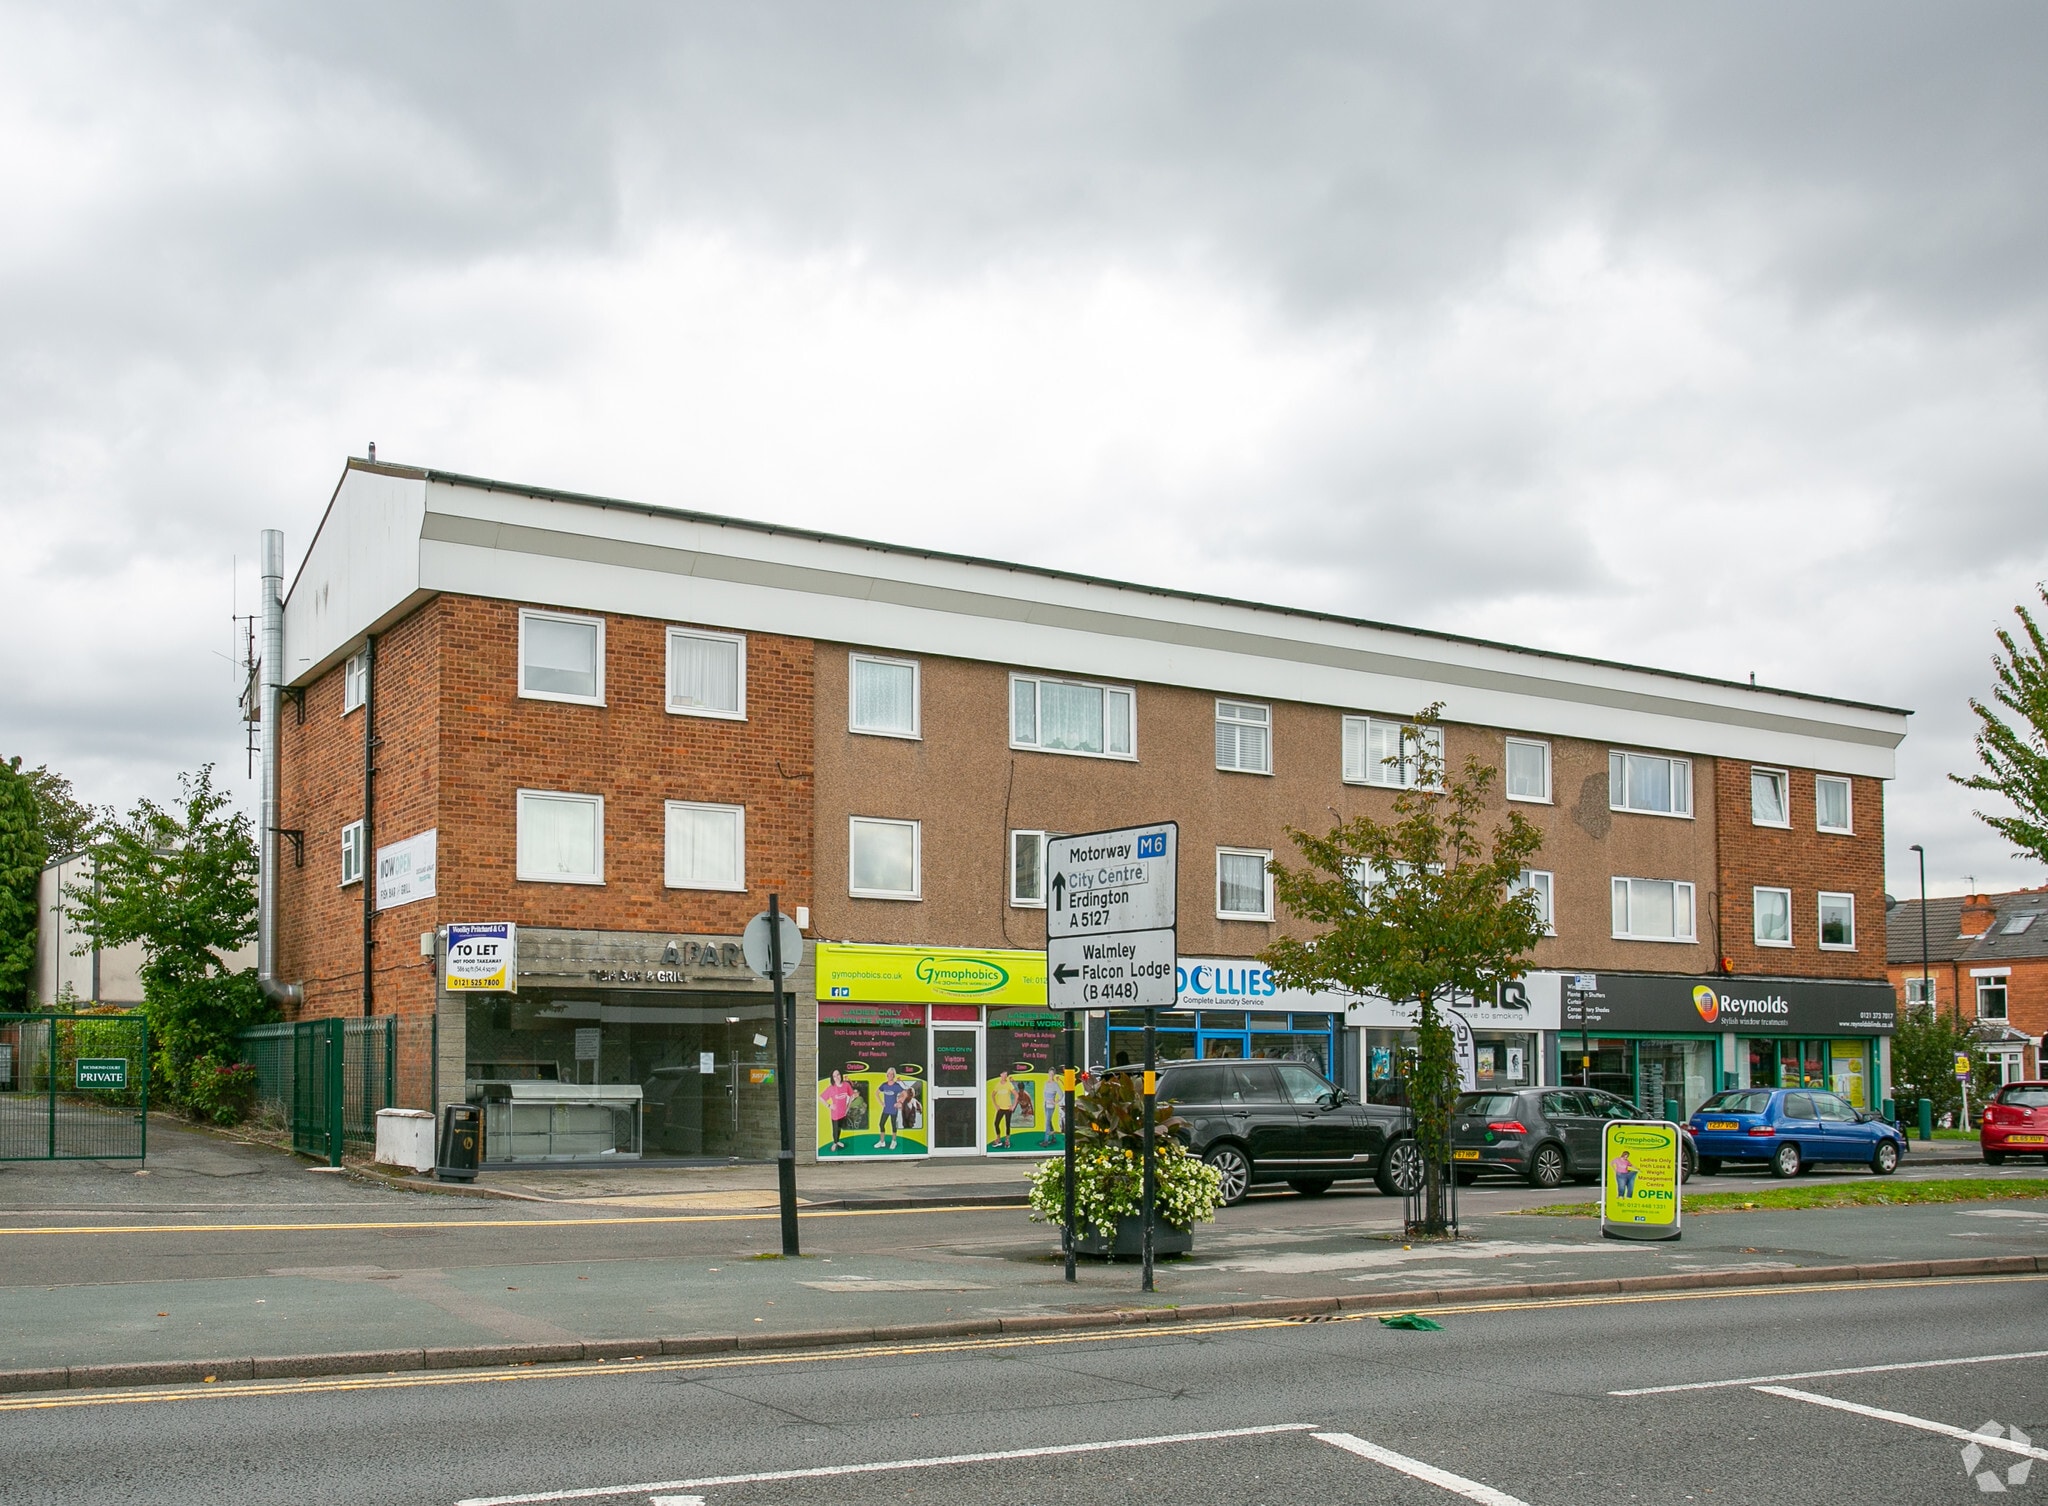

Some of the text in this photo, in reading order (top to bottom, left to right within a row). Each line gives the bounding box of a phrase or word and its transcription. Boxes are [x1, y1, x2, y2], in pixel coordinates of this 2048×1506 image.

[1069, 844, 1131, 864] Motorway
[1069, 866, 1143, 889] City Centre
[1069, 890, 1129, 909] Erdington
[457, 945, 498, 956] TO LET
[660, 940, 750, 968] APAR
[1083, 943, 1136, 960] Walmley
[646, 970, 655, 982] &
[831, 971, 903, 980] gymophobics.co.uk
[915, 957, 999, 985] Gymophobics
[1082, 962, 1171, 980] Falcon Lodge
[1183, 996, 1265, 1006] Complete Laundry Service
[1720, 995, 1789, 1015] Reynolds
[1391, 1009, 1406, 1017] The
[1492, 1012, 1523, 1021] smoking
[1721, 1018, 1739, 1026] Stylish
[1761, 1018, 1789, 1026] treatments
[80, 1072, 124, 1082] PRIVATE
[1613, 1131, 1664, 1145] Gymophobics
[1638, 1189, 1673, 1200] OPEN
